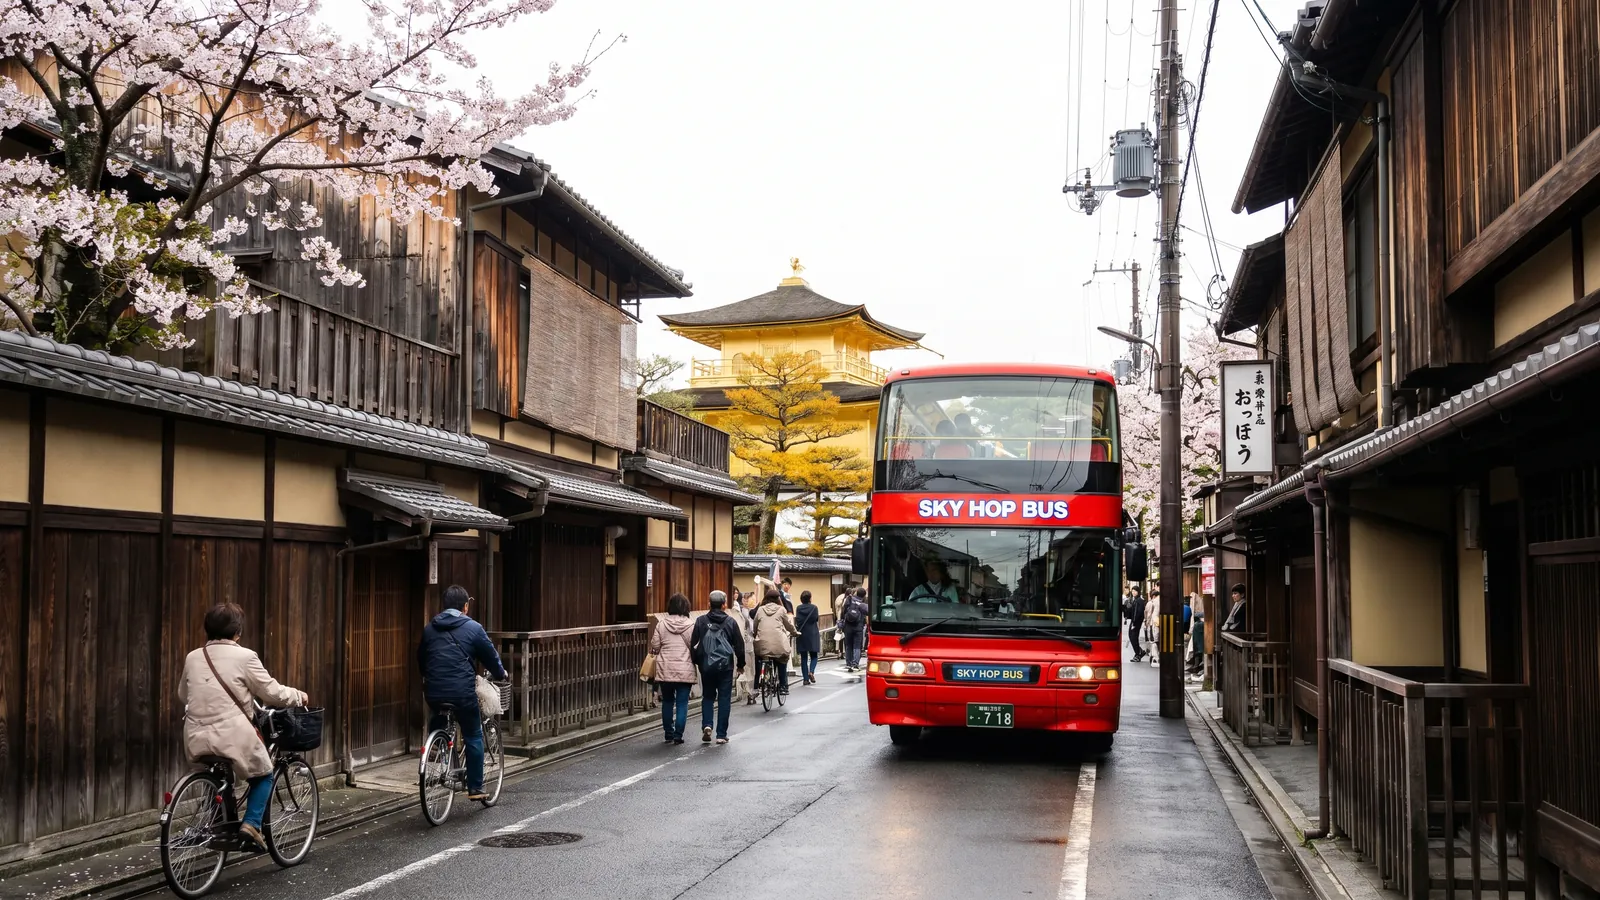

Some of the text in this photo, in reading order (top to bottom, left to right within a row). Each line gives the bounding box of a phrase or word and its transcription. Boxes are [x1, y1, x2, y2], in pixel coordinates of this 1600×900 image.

[918, 499, 1069, 520] SKY HOP BUS
[956, 669, 1024, 679] SKY HOP BUS
